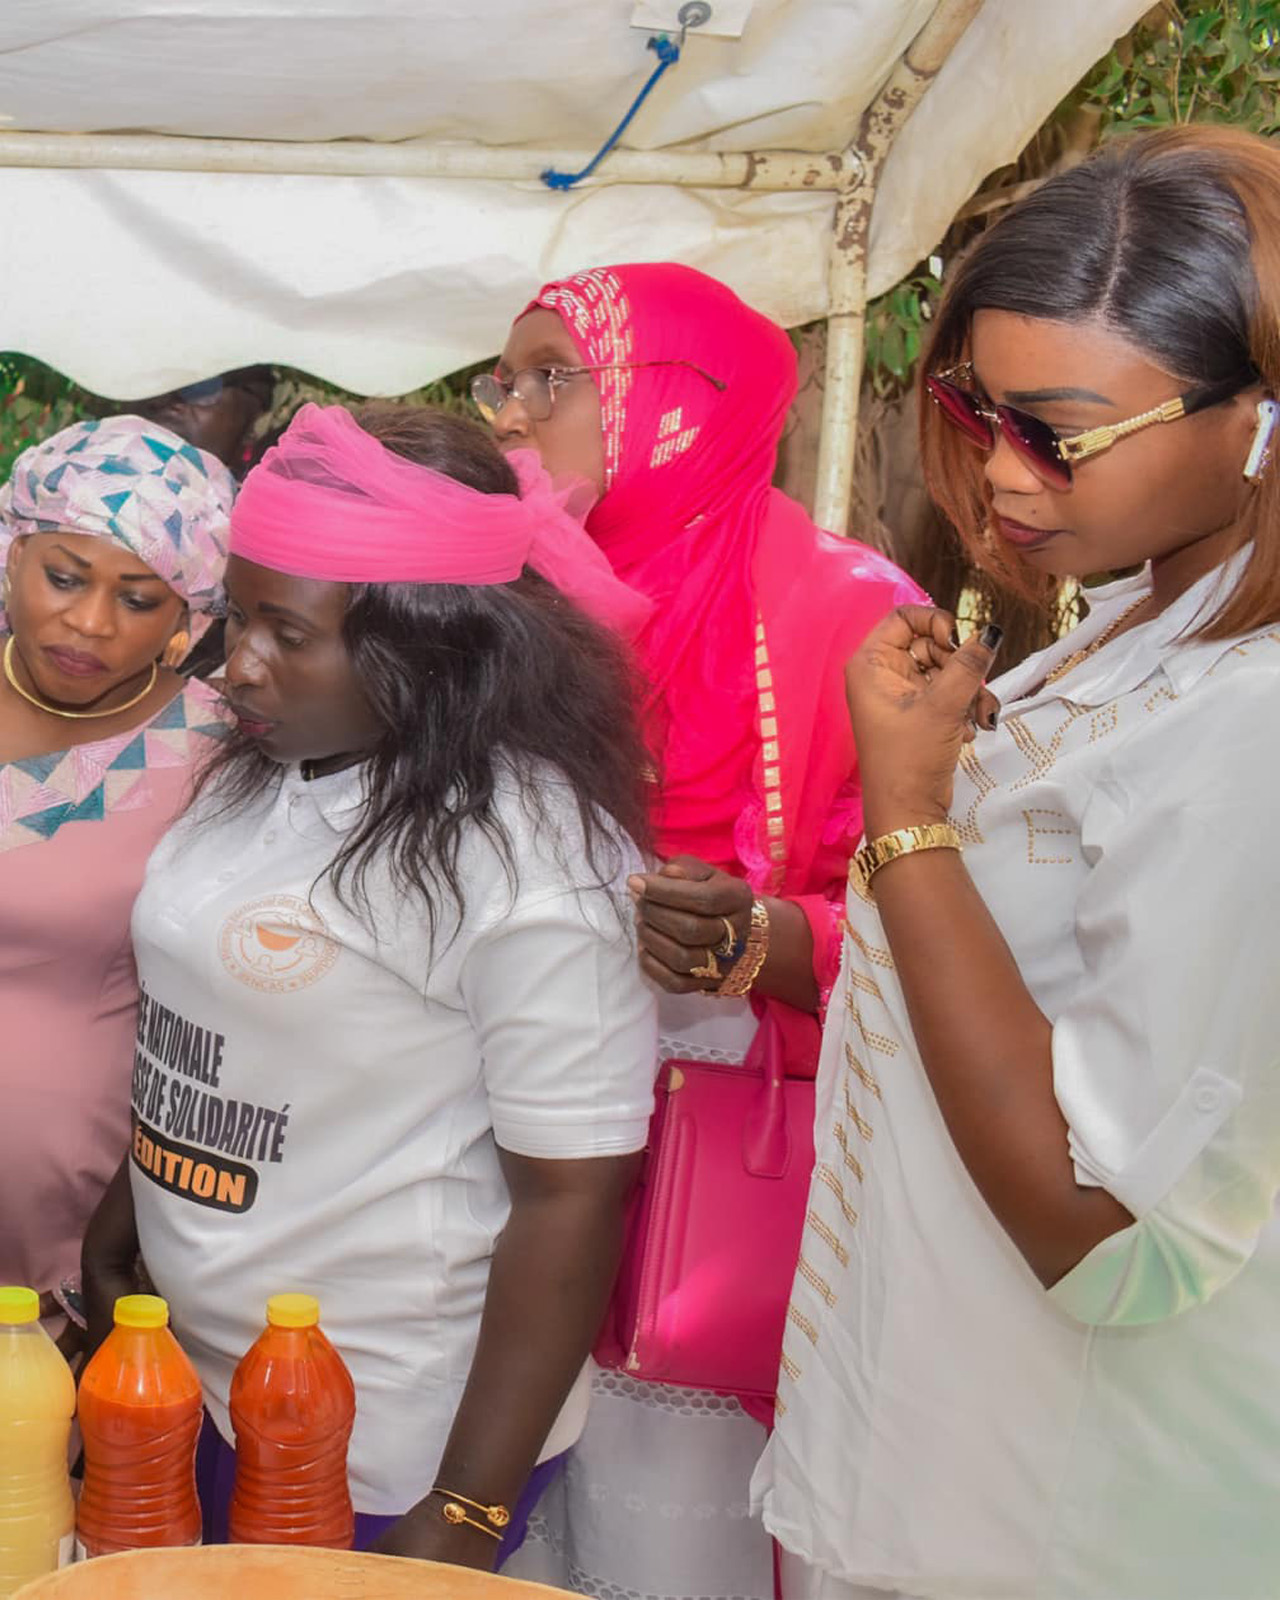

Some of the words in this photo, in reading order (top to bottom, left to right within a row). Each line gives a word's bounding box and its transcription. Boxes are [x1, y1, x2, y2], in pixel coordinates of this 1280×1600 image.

[146, 998, 225, 1088] NATIONALE
[146, 1067, 168, 1126] DE
[165, 1078, 290, 1163] SOLIDARITÉ
[134, 1125, 246, 1206] ÉDITION
